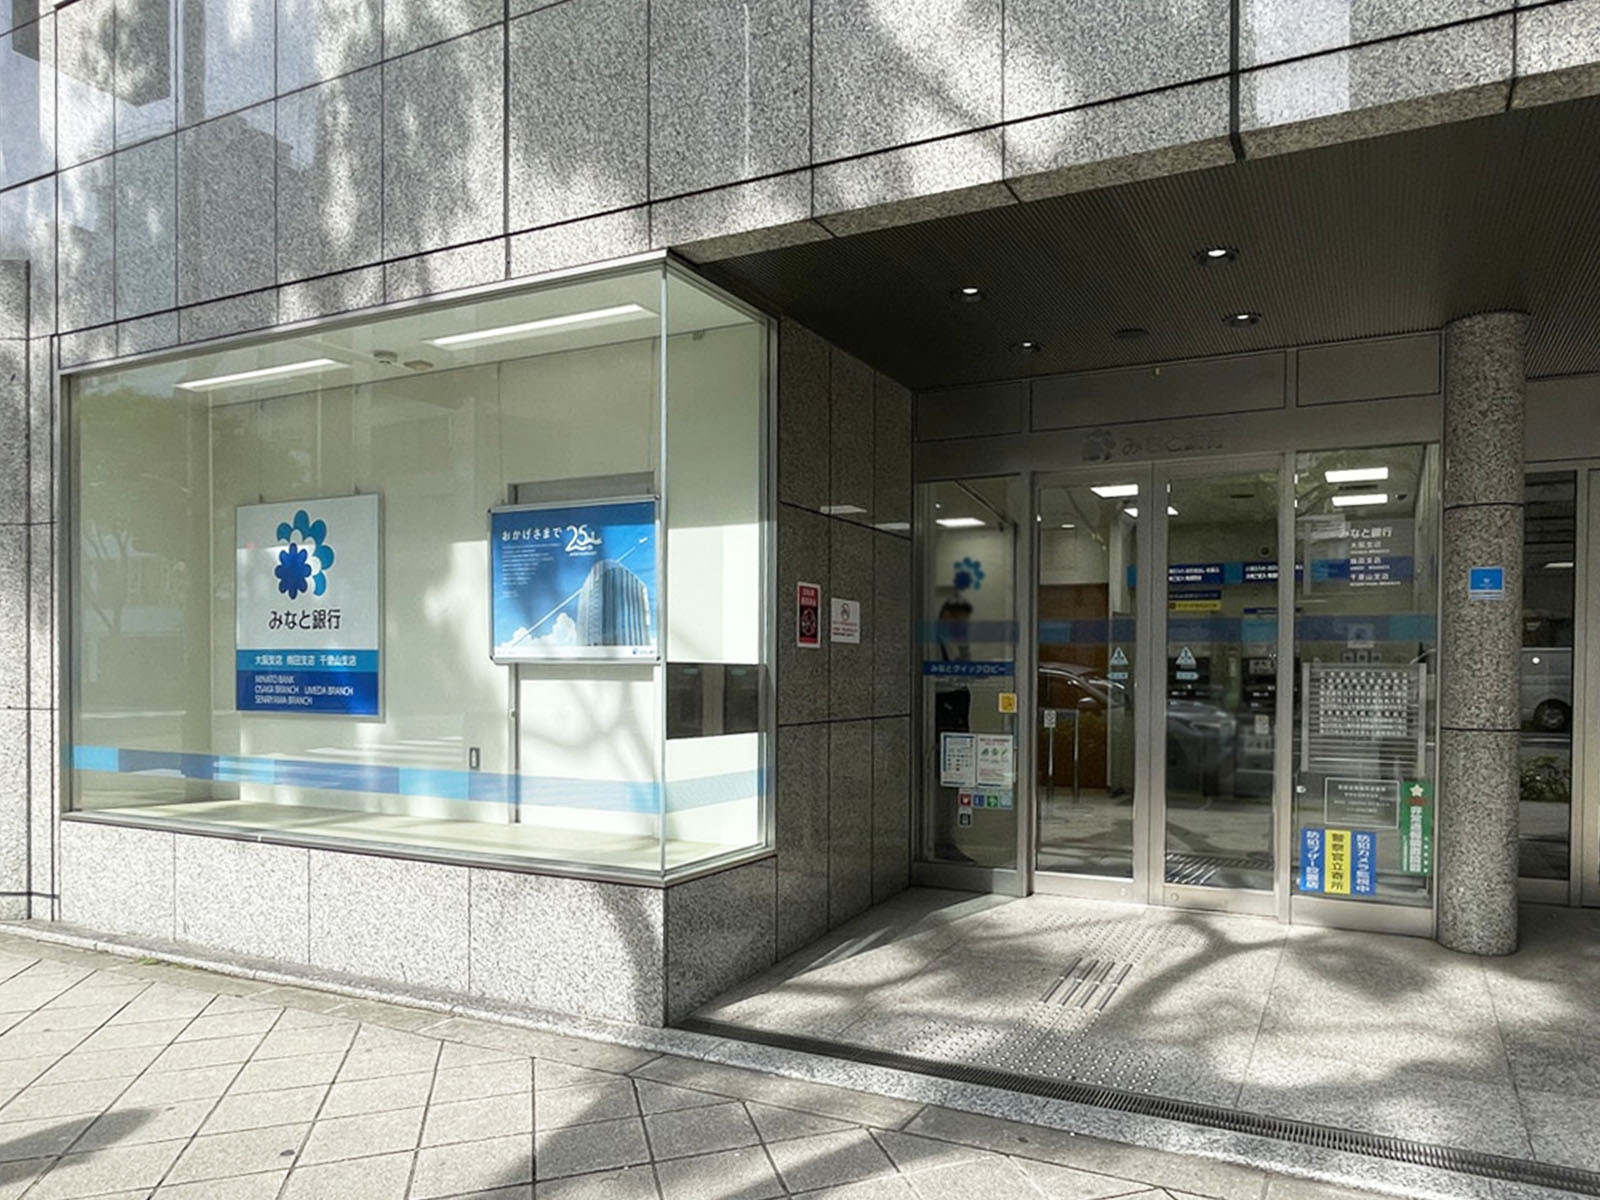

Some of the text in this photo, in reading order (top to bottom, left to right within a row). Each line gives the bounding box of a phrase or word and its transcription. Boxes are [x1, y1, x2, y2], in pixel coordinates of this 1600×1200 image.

[502, 526, 563, 541] おかげさまで
[268, 609, 341, 630] みなと銀行
